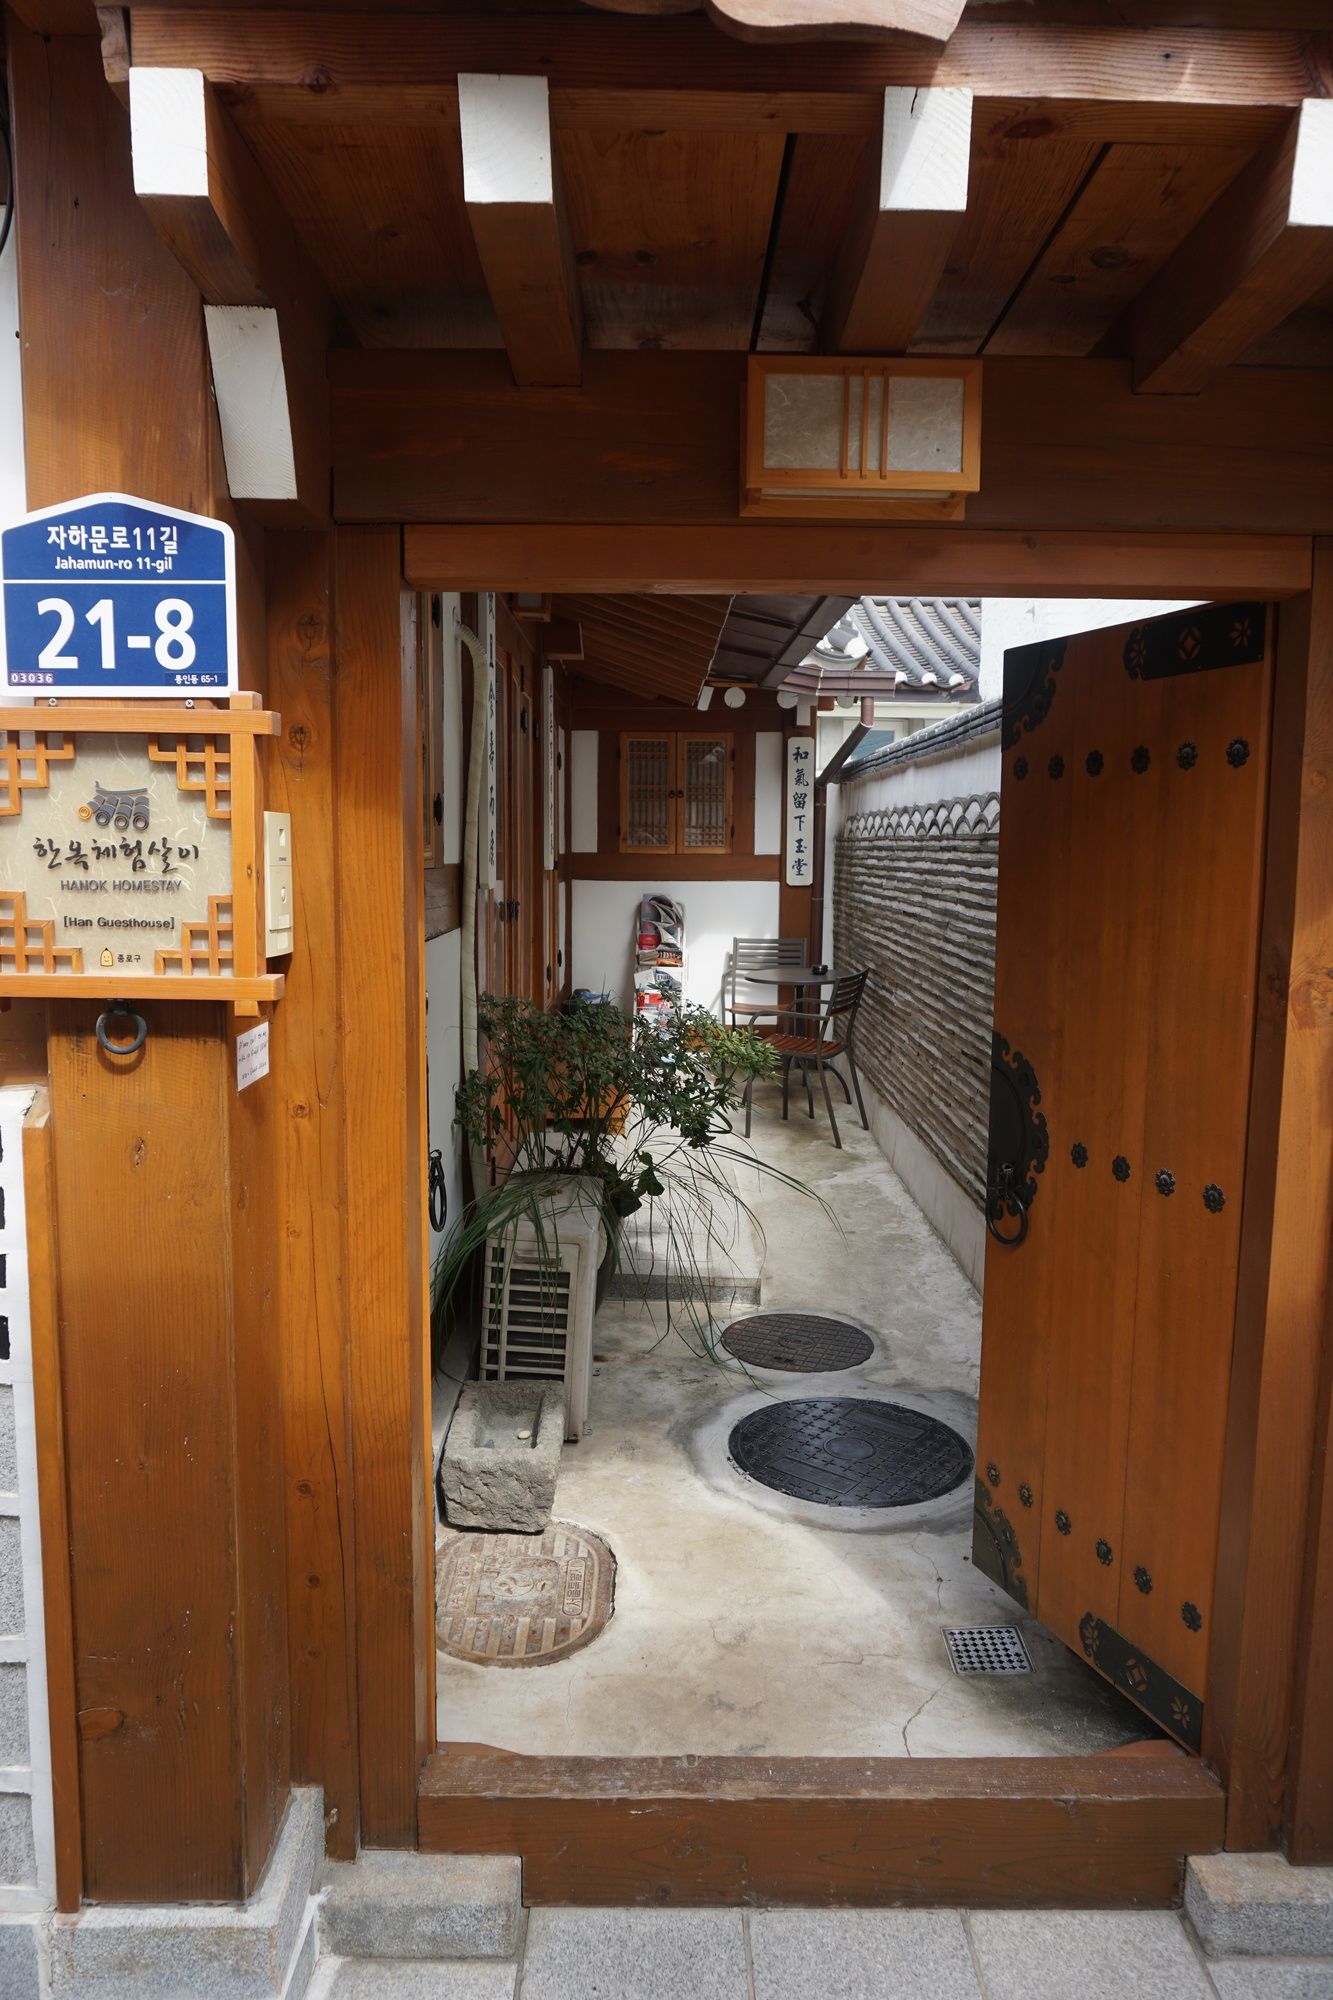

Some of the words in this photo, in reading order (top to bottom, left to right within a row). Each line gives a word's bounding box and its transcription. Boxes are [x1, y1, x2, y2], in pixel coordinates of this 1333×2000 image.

[47, 525, 178, 554] 자하문로11길
[55, 557, 132, 570] Jahamun-ro
[136, 557, 172, 573] 11-gil
[37, 597, 196, 670] 21-8
[11, 674, 53, 683] 03036
[200, 674, 218, 683] 65-1
[60, 879, 107, 892] HANOK
[112, 879, 182, 892] HOMESTAY
[63, 915, 93, 928] [Han
[97, 916, 175, 930] Guesthouse]
[117, 953, 141, 963] 종로구
